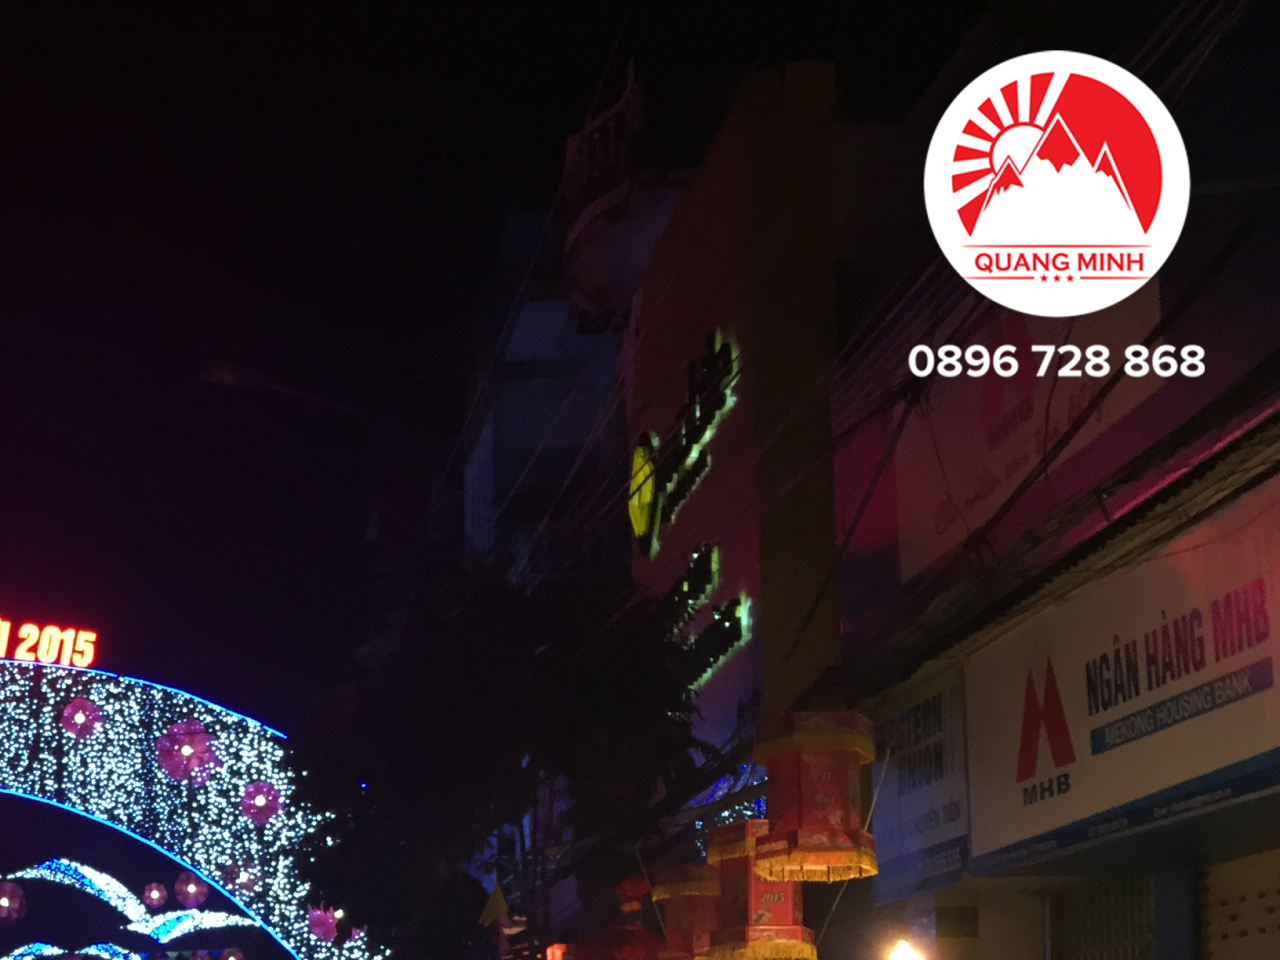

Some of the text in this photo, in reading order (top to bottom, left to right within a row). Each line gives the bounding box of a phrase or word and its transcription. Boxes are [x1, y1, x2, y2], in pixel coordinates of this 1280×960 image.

[14, 623, 98, 668] 2015
[1085, 578, 1271, 717] NGÂN HÀNG MHB
[1104, 668, 1253, 746] MEKONG HOUSING BANK
[1022, 773, 1072, 806] MHB
[760, 892, 785, 903] 2015
